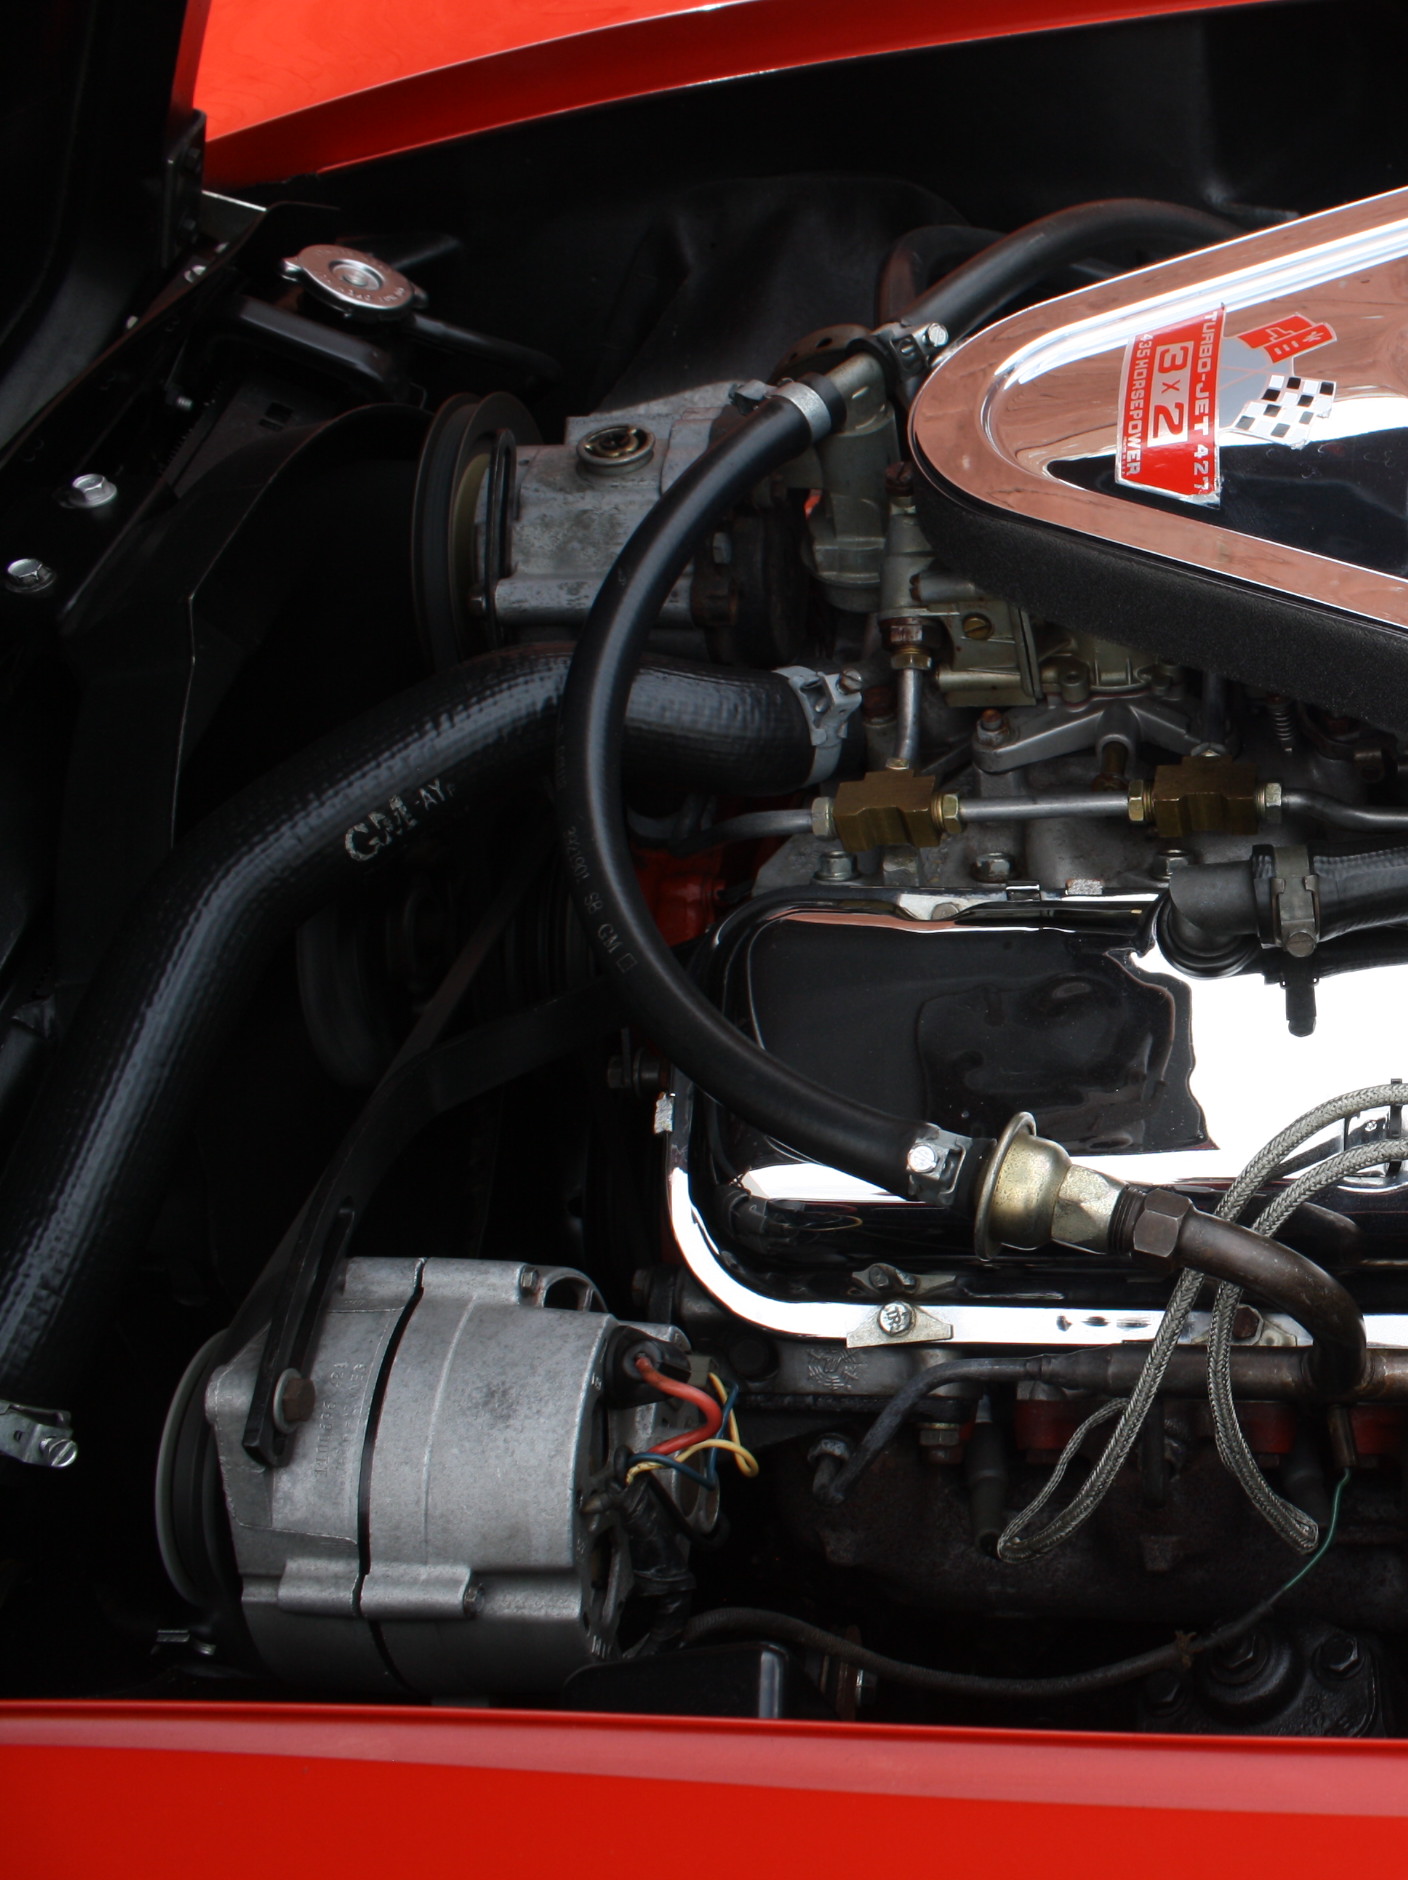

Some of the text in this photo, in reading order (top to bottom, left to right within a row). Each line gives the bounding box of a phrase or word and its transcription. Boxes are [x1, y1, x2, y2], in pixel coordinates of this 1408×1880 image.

[1158, 346, 1188, 374] 3
[1127, 334, 1154, 476] 435 HORSEPOWER
[1193, 311, 1217, 491] TURBO-JET 427
[1153, 402, 1185, 438] 2
[598, 923, 624, 954] GM
